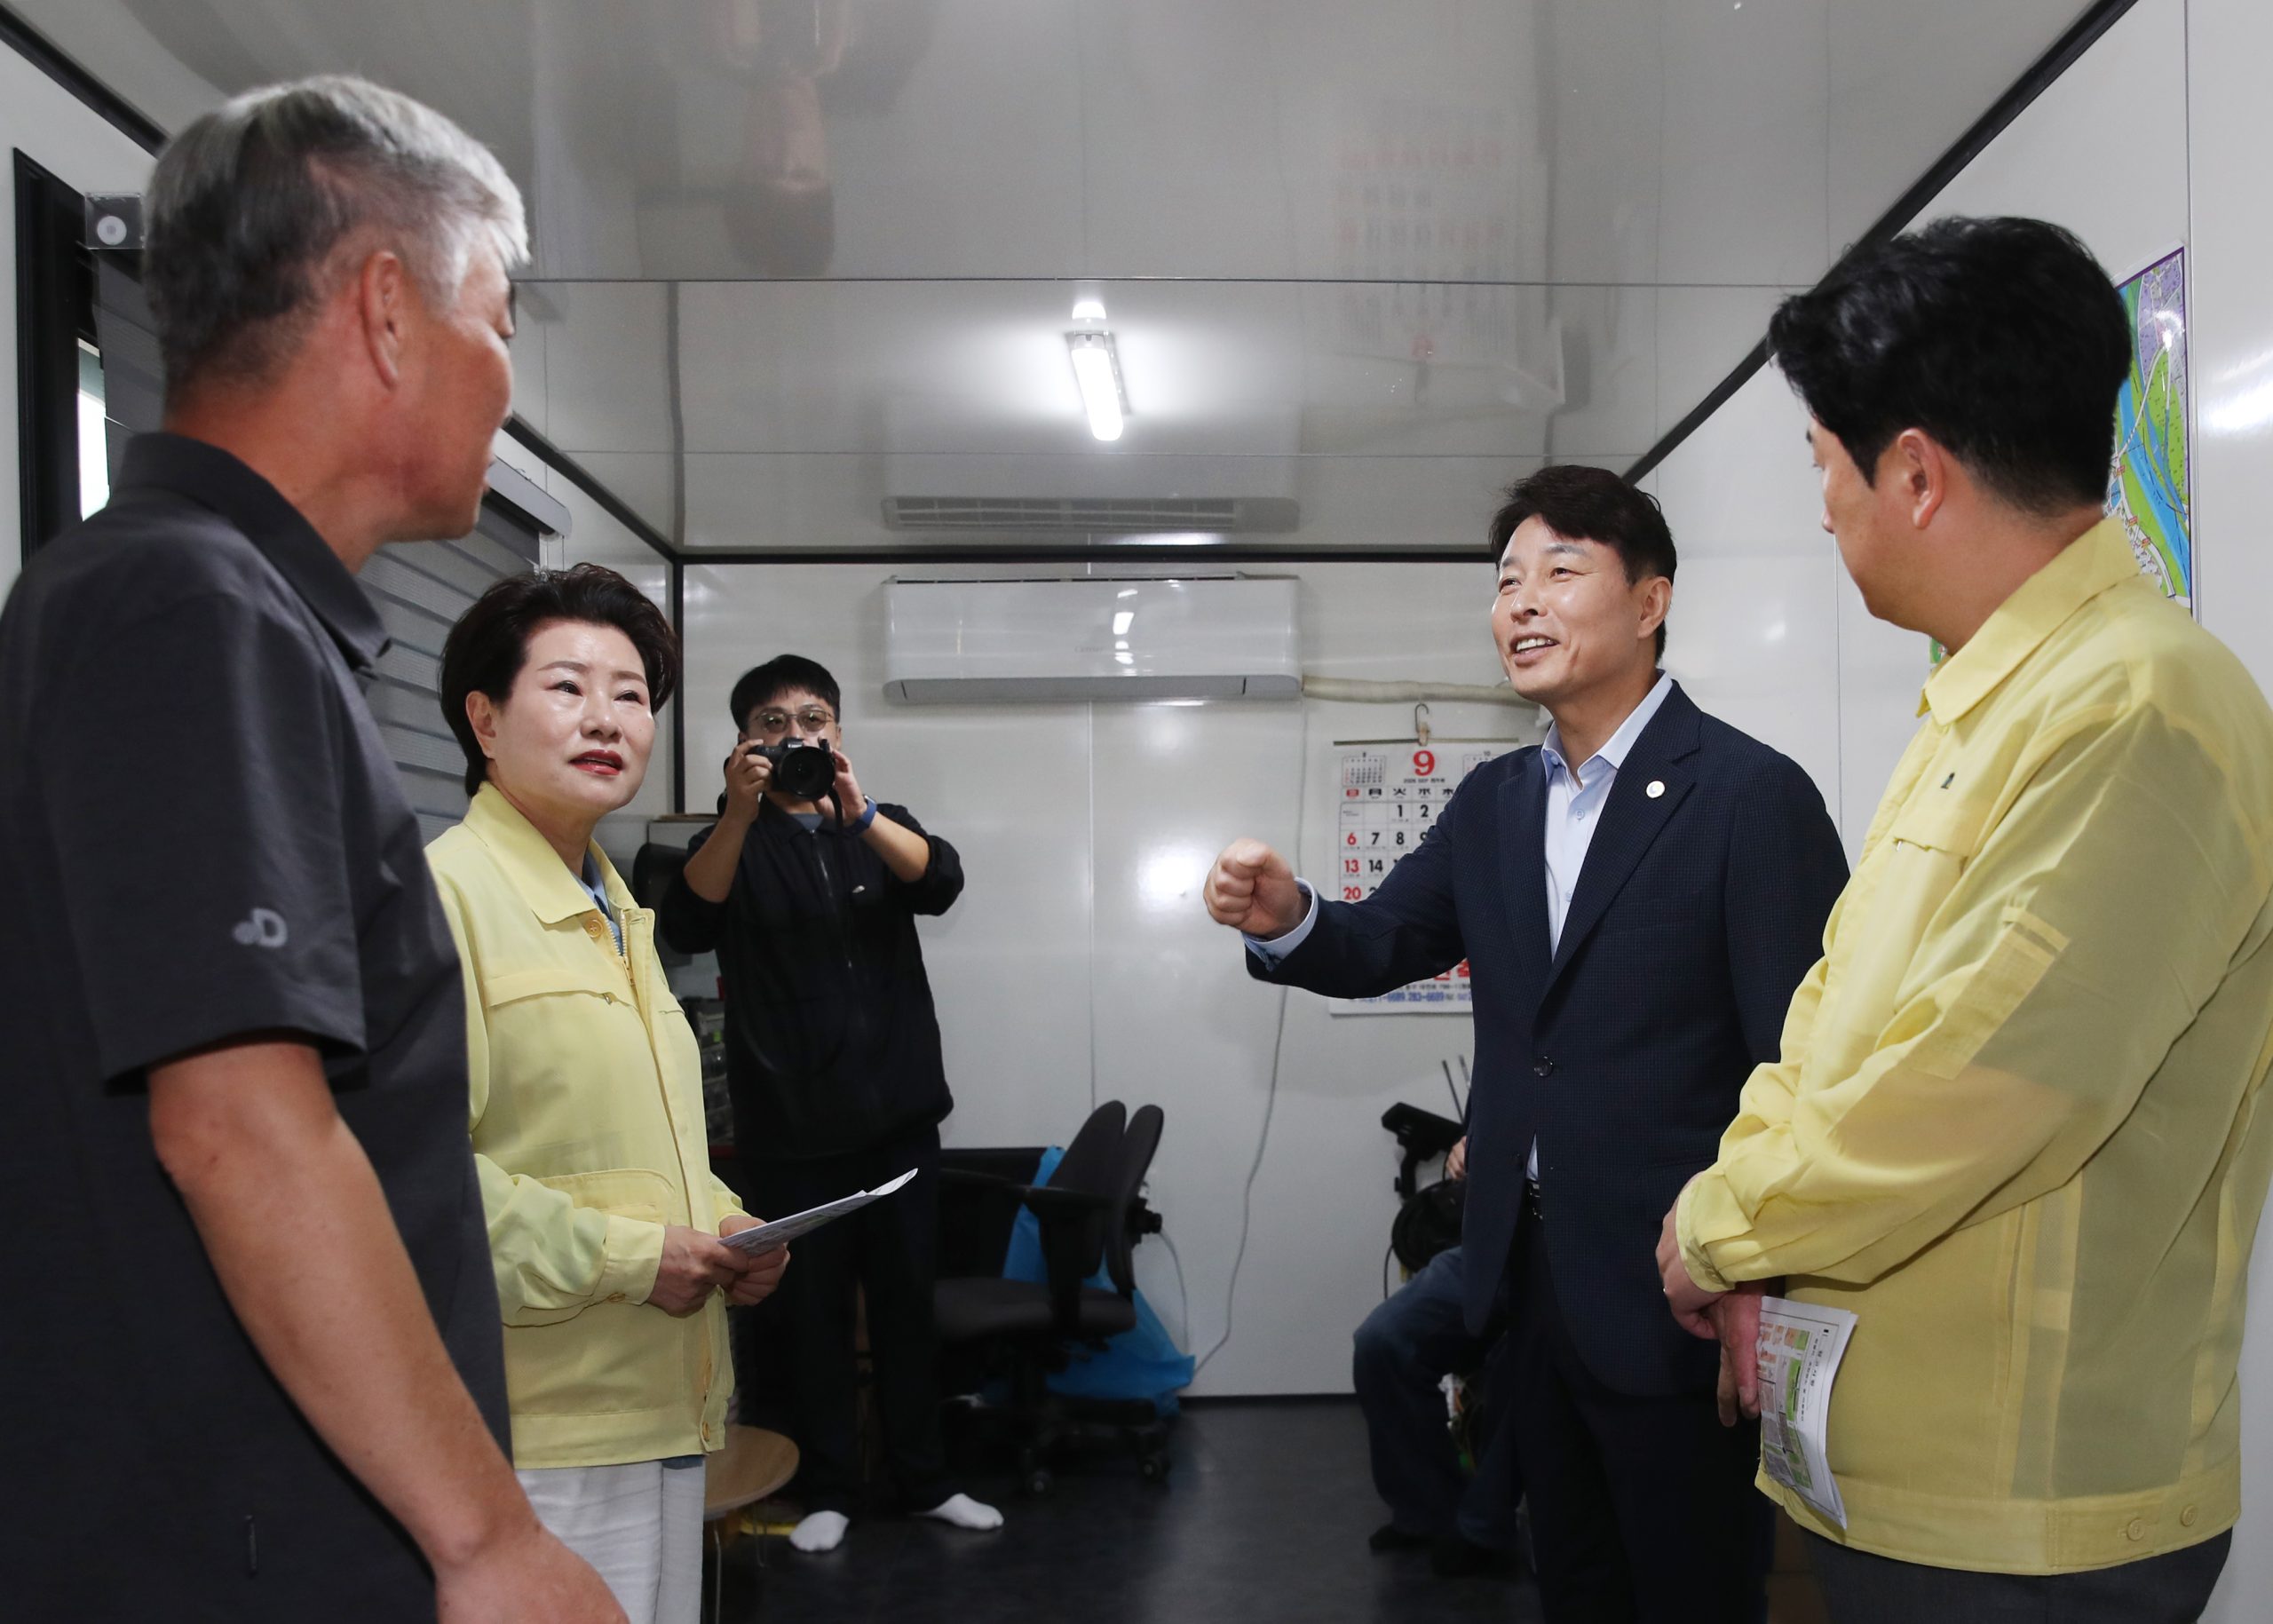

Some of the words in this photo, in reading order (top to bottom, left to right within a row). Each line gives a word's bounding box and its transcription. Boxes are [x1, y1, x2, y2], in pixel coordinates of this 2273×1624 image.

[1413, 750, 1435, 776] 9
[1398, 804, 1403, 818] 1
[1420, 804, 1429, 818] 2
[1347, 832, 1357, 845] 6
[1372, 832, 1380, 844] 7
[1396, 832, 1405, 845] 8
[1344, 860, 1359, 873] 13
[1368, 860, 1383, 873] 14
[1343, 886, 1361, 900] 20
